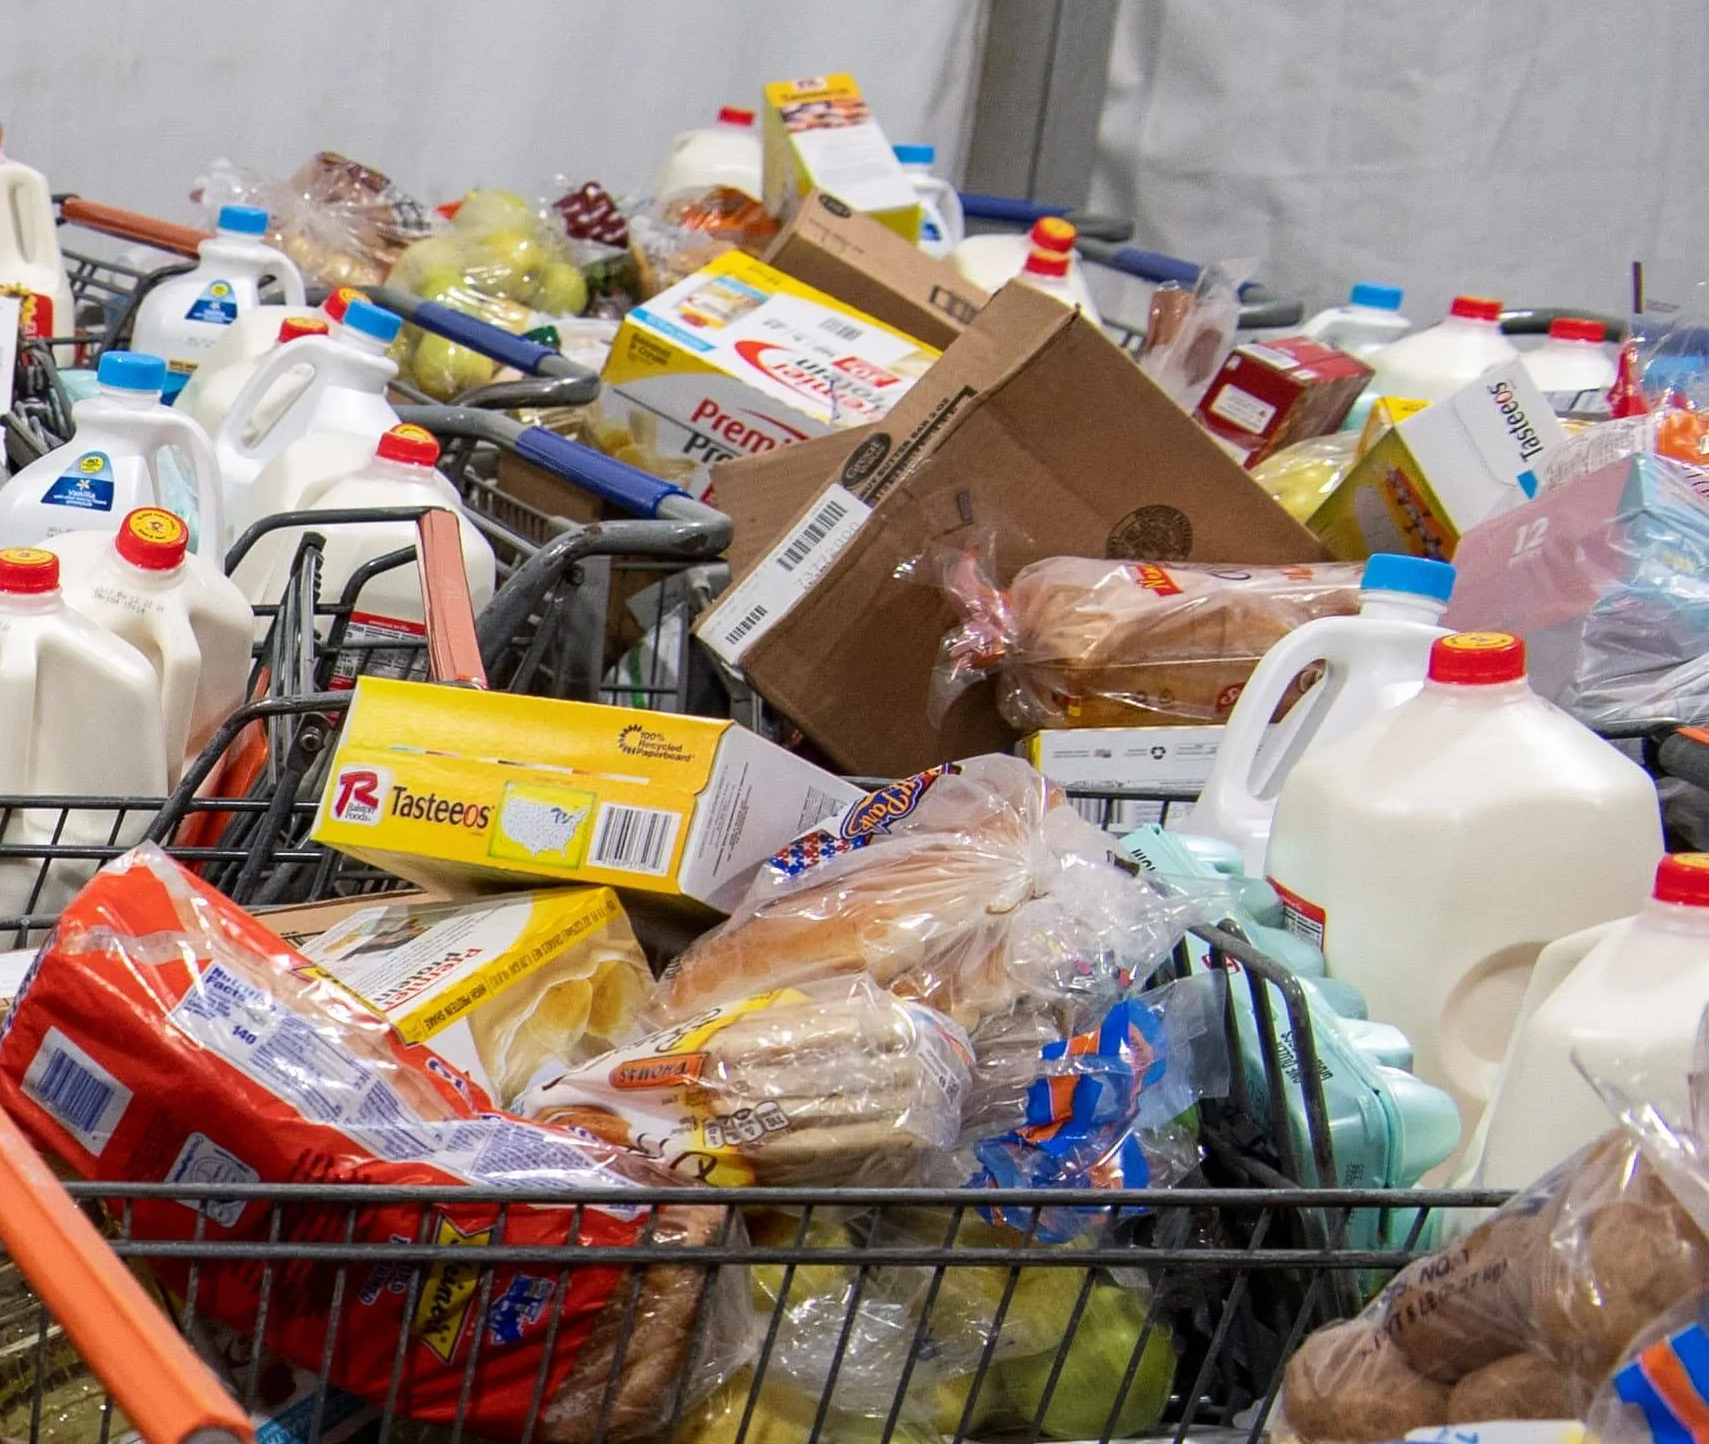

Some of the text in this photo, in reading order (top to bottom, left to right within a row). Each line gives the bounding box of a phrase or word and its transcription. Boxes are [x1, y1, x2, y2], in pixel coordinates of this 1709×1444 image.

[690, 397, 791, 453] Prem
[1488, 380, 1545, 463] Tasteeos
[1513, 515, 1550, 553] 12
[635, 747, 693, 763] Paperboard
[637, 738, 684, 753] Recycled
[638, 730, 666, 742] 100%
[335, 770, 380, 817] R
[390, 784, 490, 831] Tasteeos
[231, 1024, 257, 1045] 140
